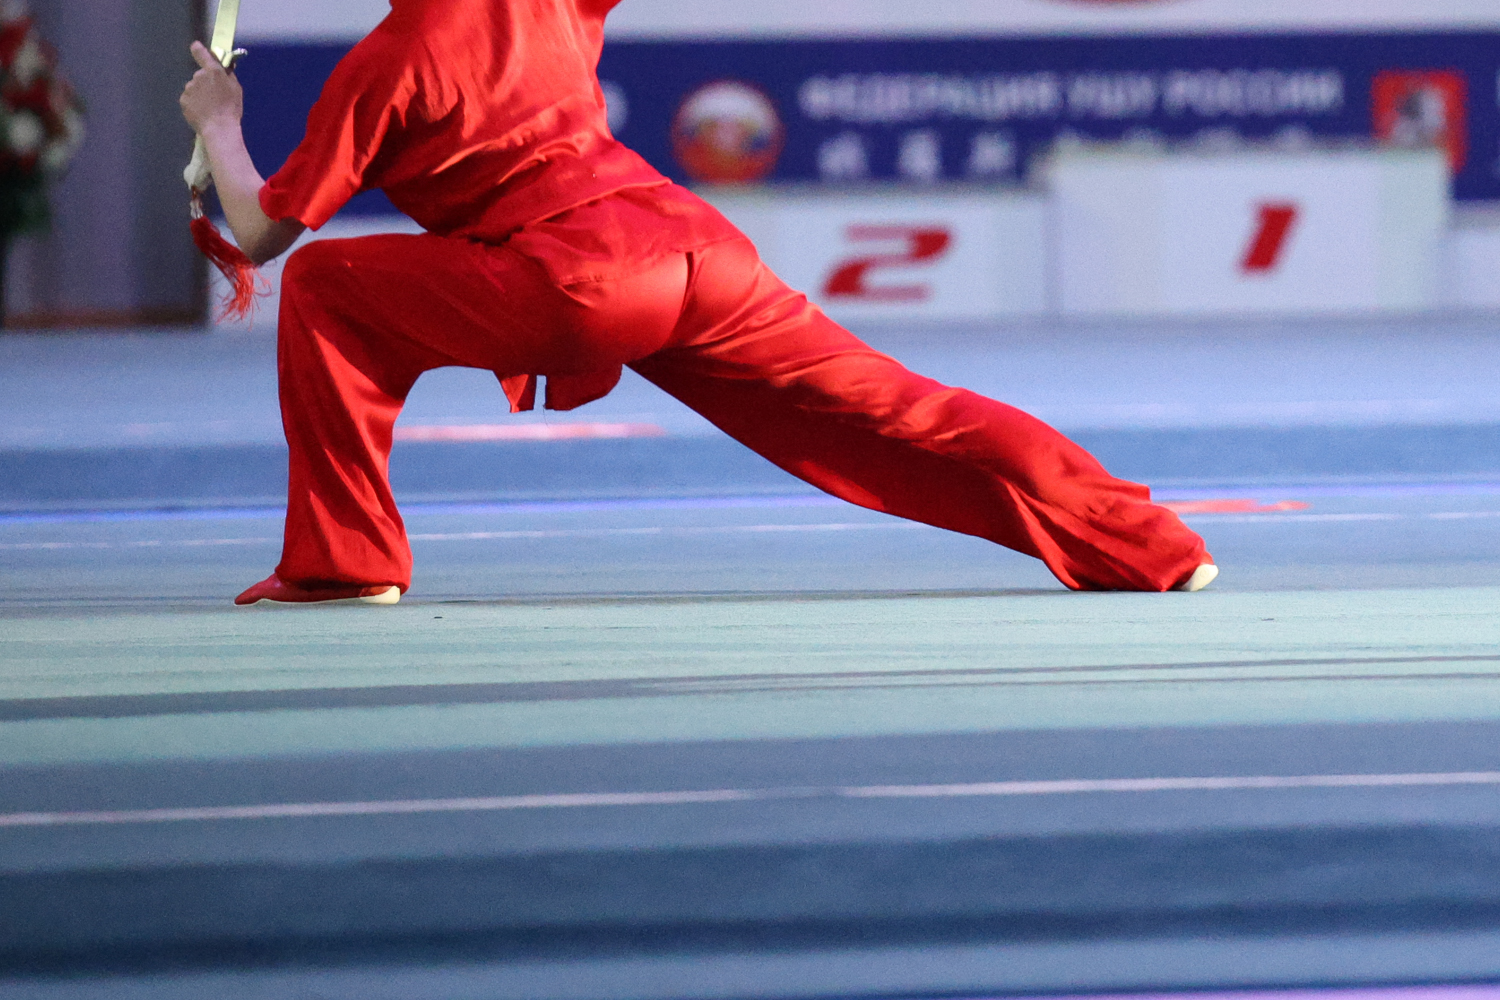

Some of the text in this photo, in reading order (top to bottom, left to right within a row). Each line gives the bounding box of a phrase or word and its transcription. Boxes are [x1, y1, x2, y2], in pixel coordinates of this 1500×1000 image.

[801, 69, 1343, 120] ФЕДЕРАЦИЯ УШУ РОССИИ
[821, 222, 953, 302] 2
[1239, 200, 1299, 275] 1
